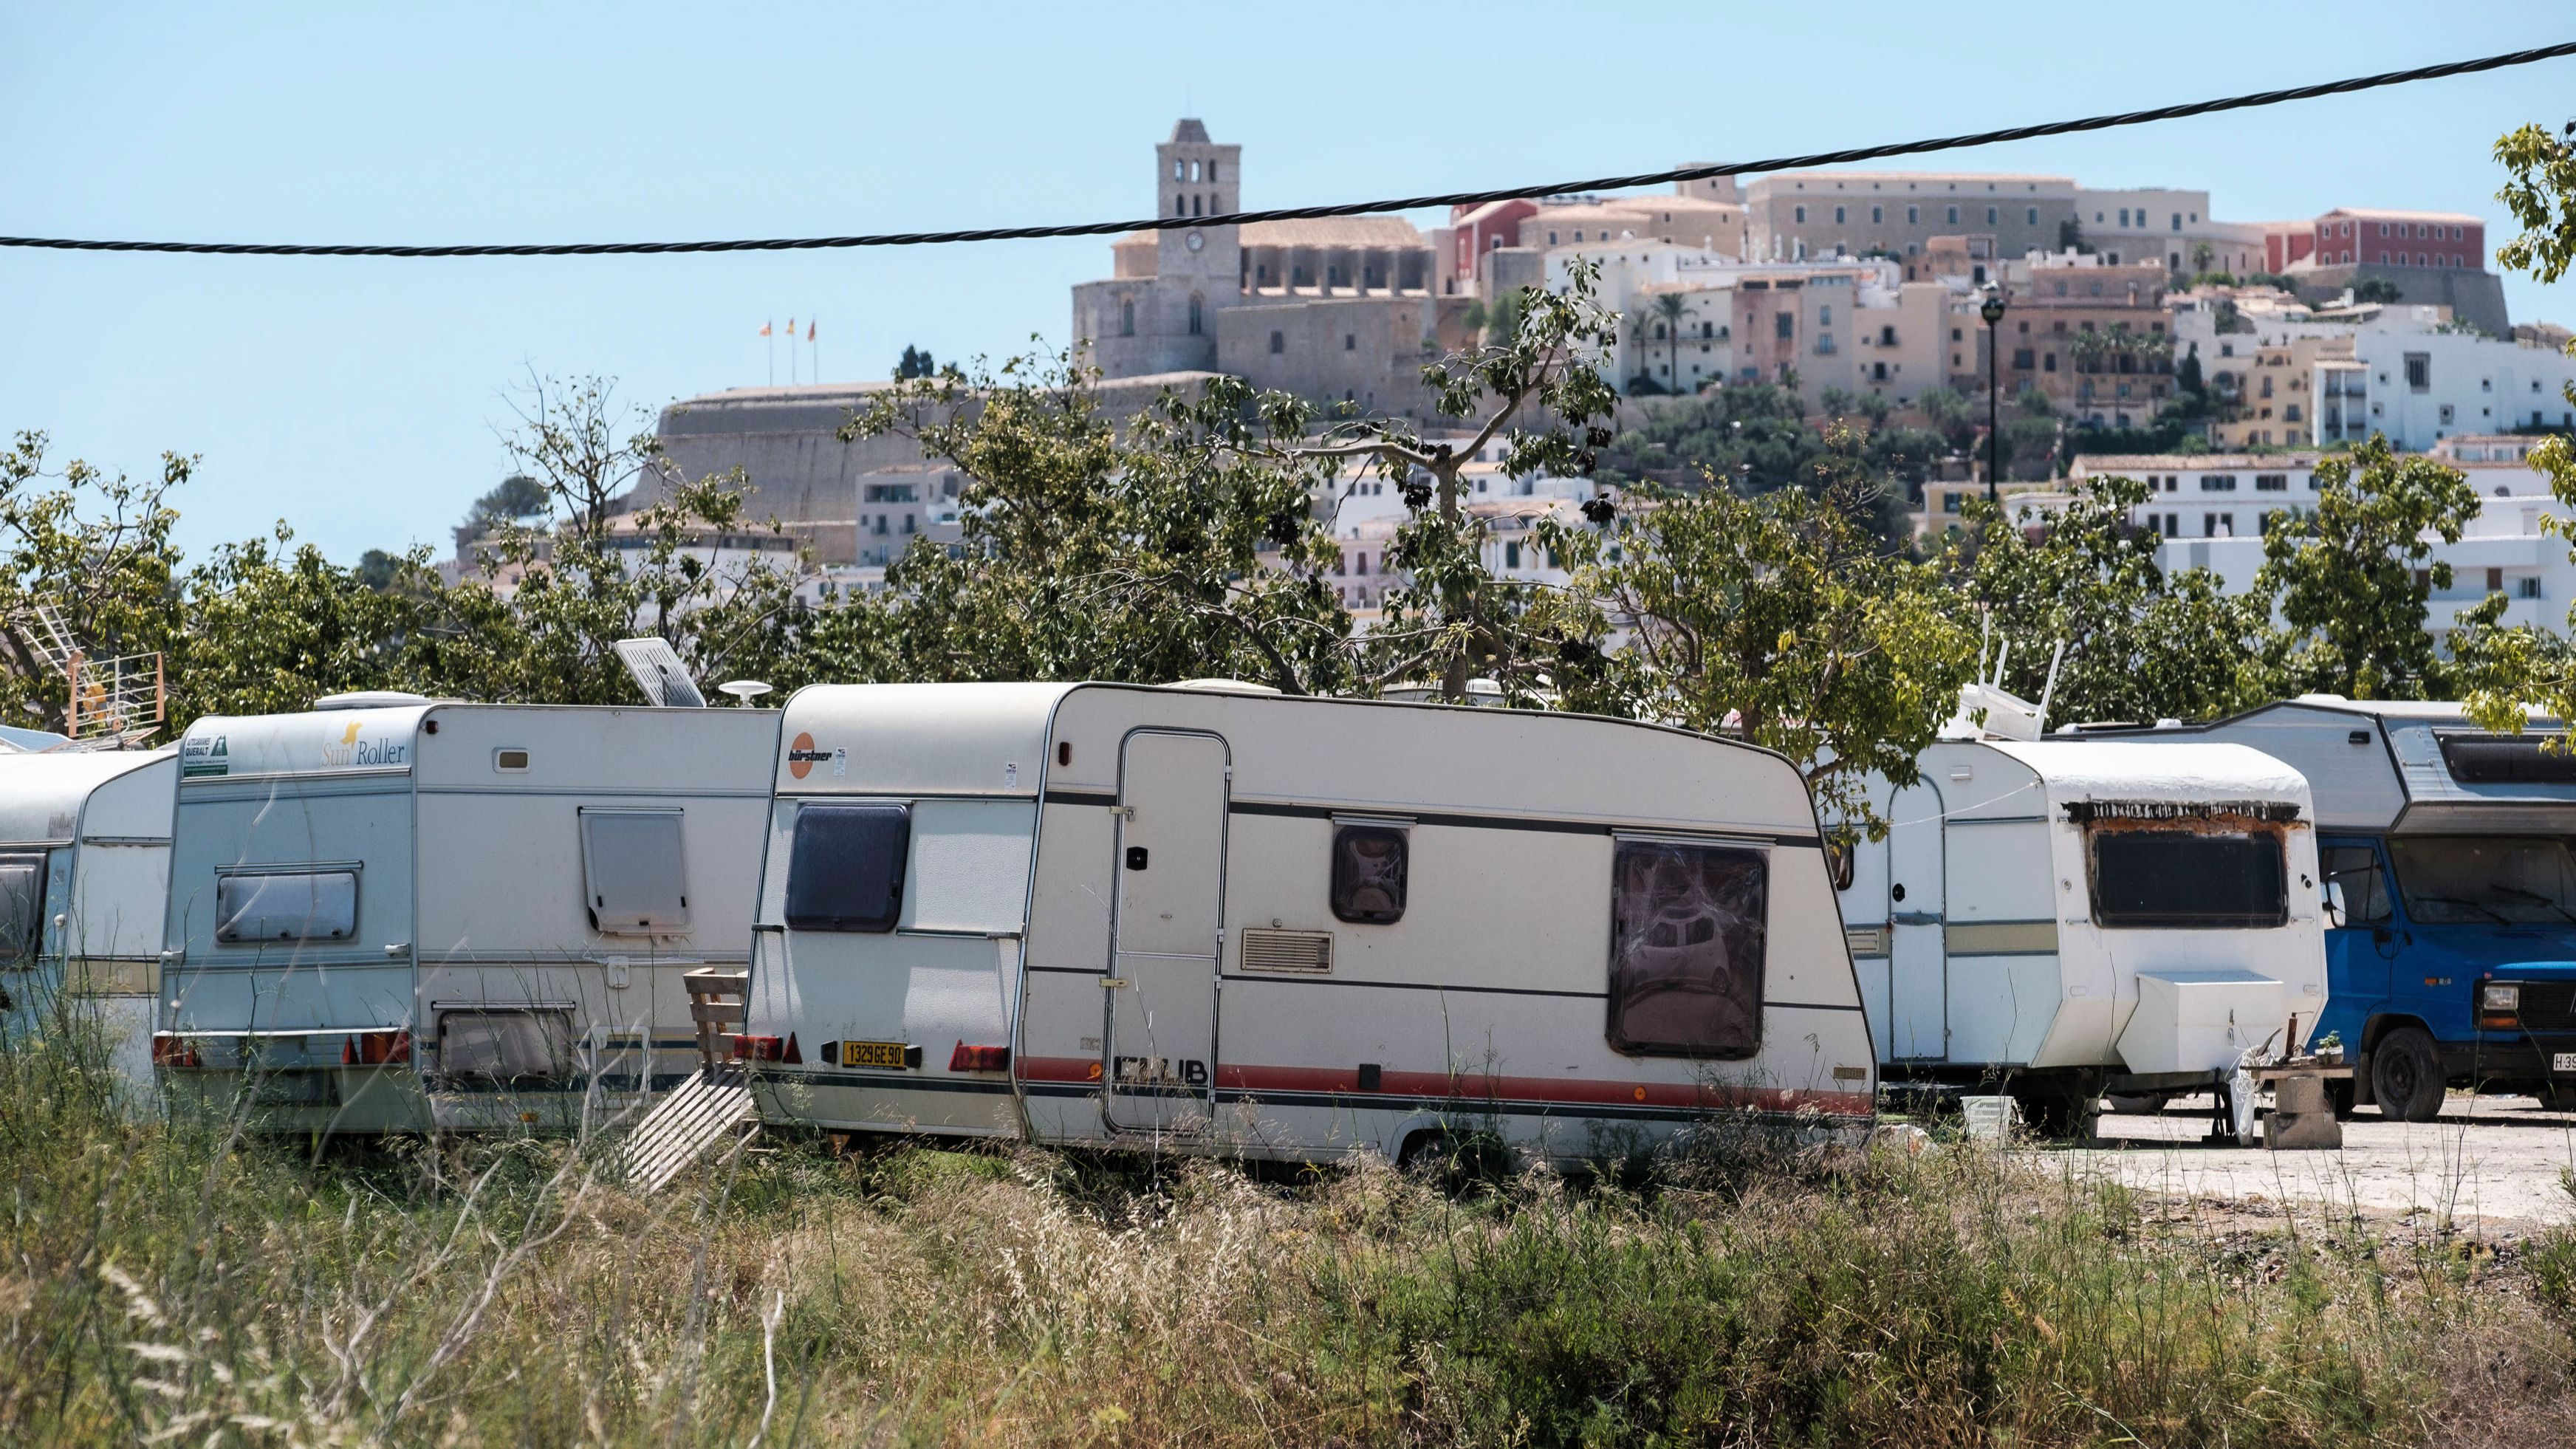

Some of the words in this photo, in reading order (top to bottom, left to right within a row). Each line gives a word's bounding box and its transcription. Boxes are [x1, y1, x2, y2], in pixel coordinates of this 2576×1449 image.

[185, 747, 209, 757] QUERALT
[321, 742, 350, 767] Sun
[356, 738, 405, 765] Roller
[788, 750, 832, 761] bürstner
[850, 1044, 873, 1063] 1329
[874, 1045, 886, 1064] GE
[888, 1046, 901, 1064] 90
